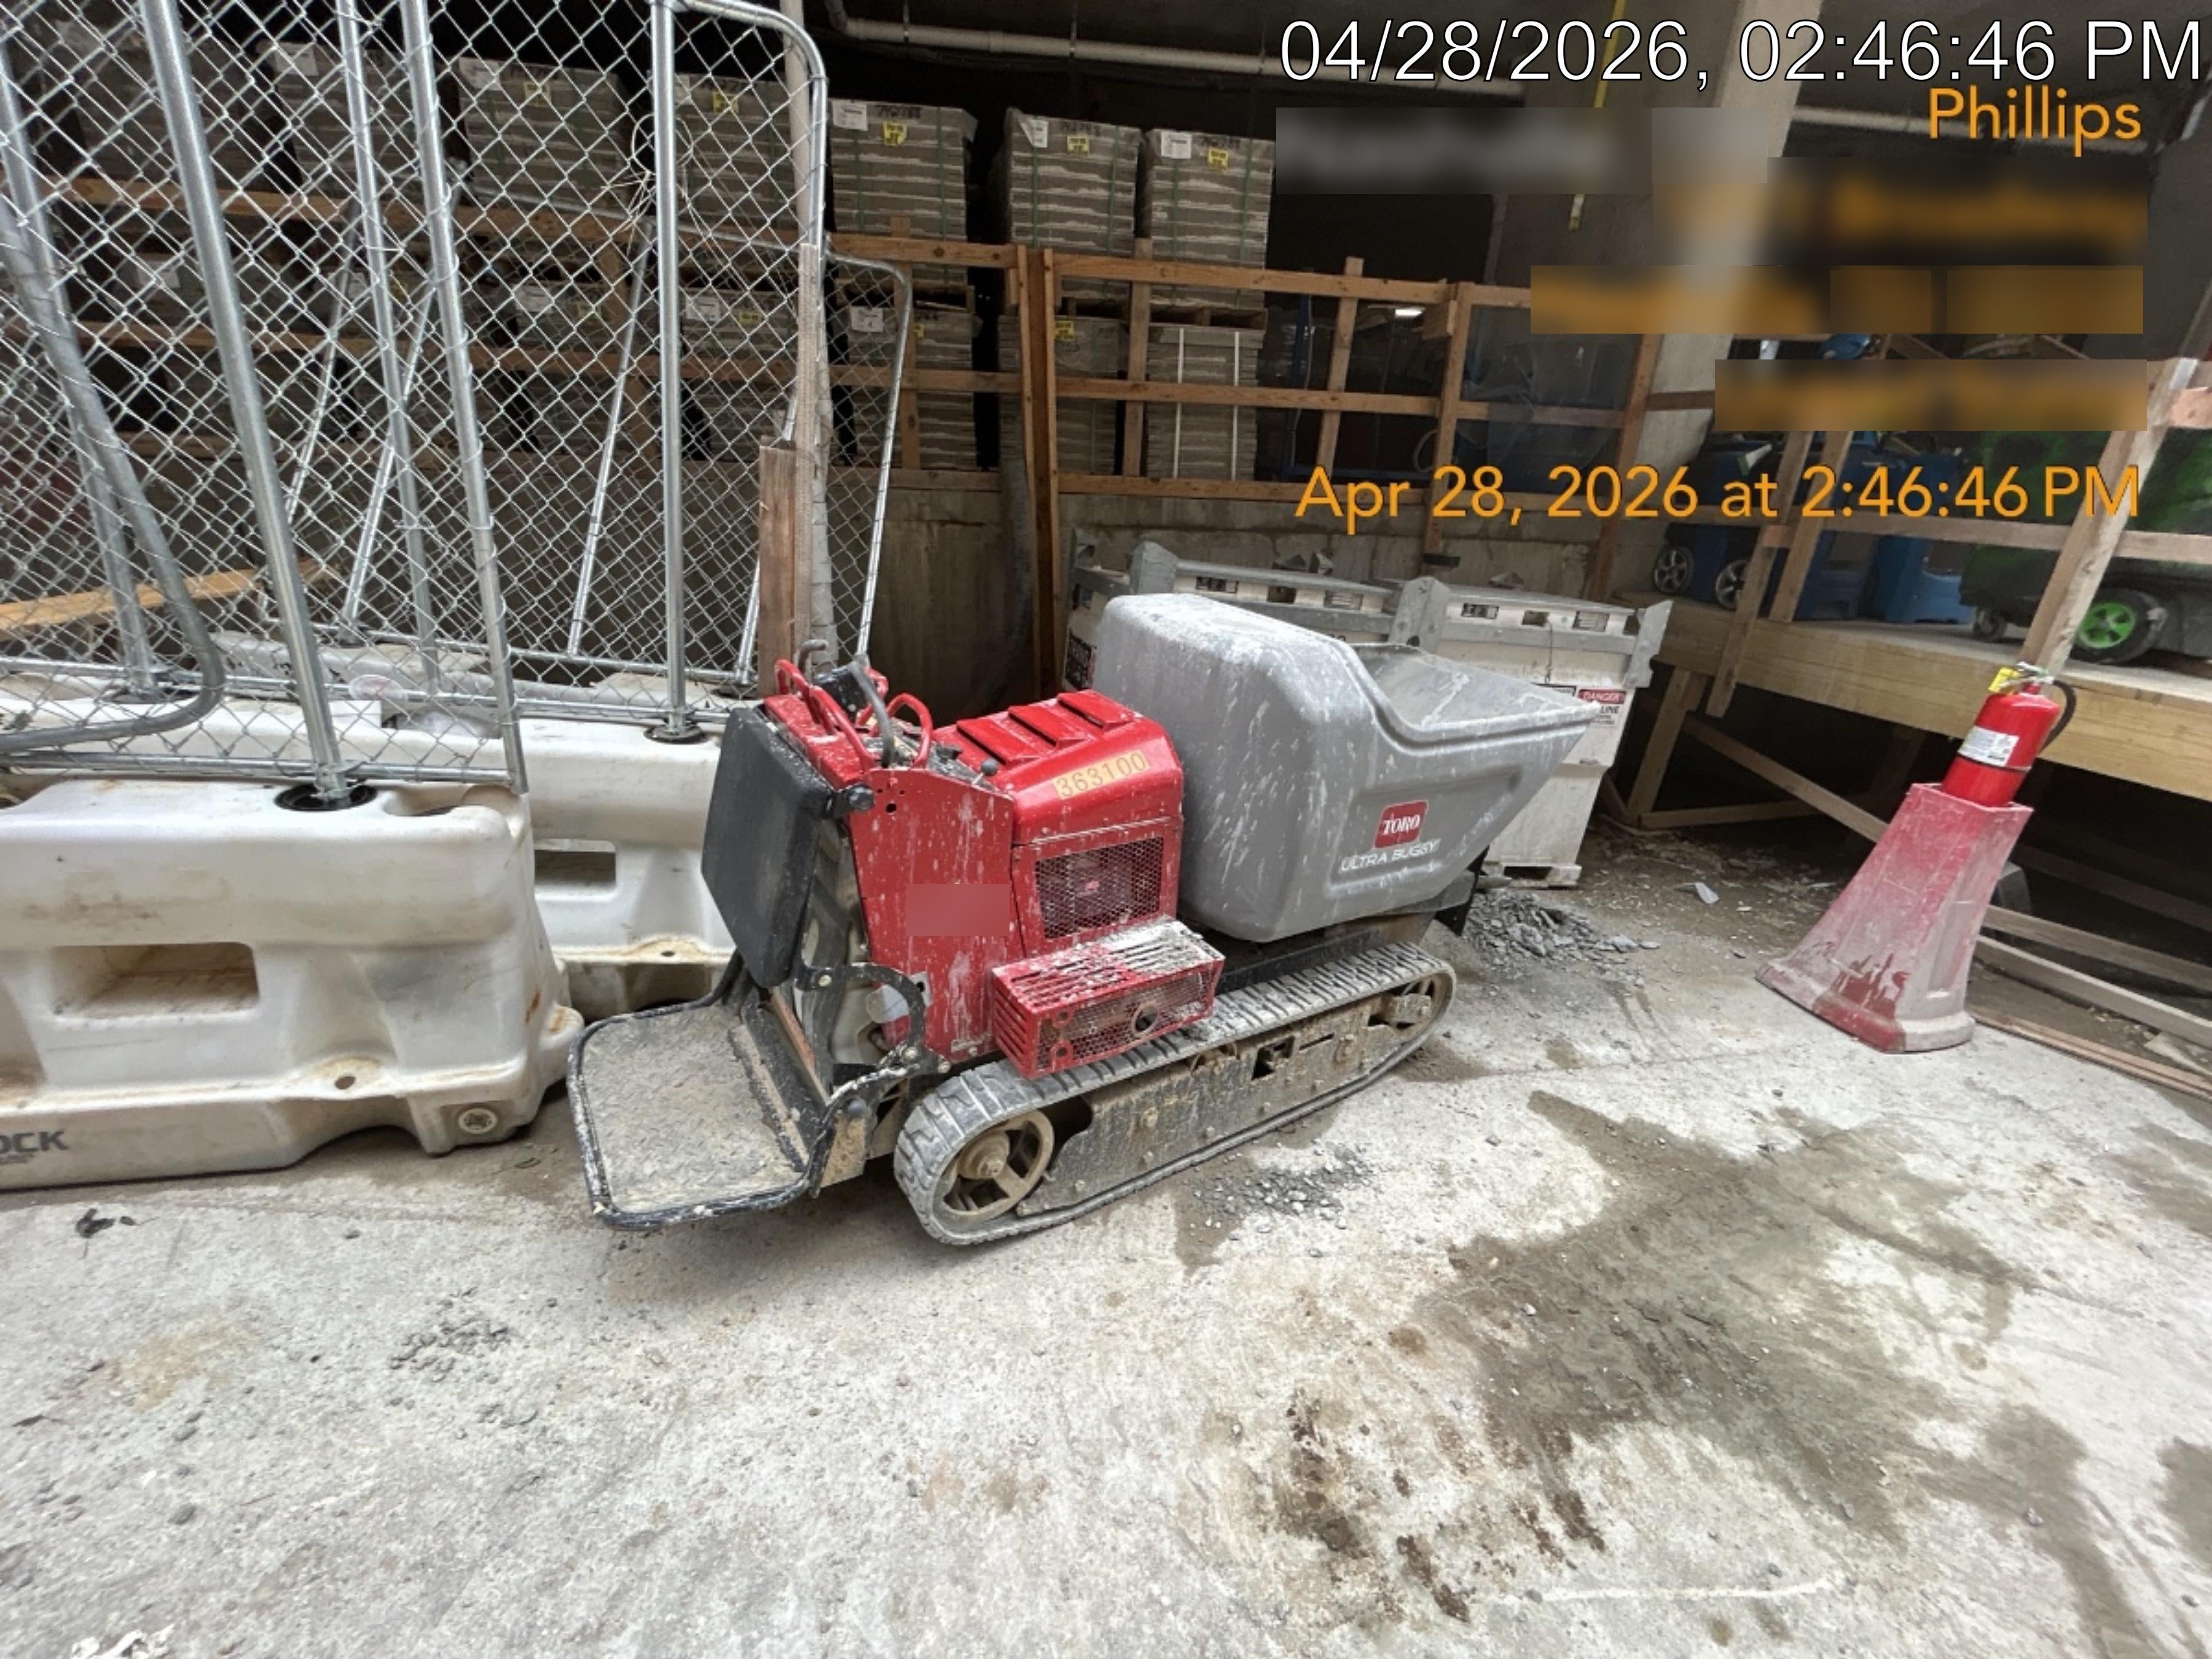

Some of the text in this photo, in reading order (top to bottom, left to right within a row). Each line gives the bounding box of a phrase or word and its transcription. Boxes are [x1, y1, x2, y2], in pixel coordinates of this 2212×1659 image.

[1582, 691, 1620, 702] DANGER
[1056, 751, 1146, 797] 363100
[1382, 814, 1421, 836] TORO
[1341, 837, 1442, 871] ULTRA BUGGY
